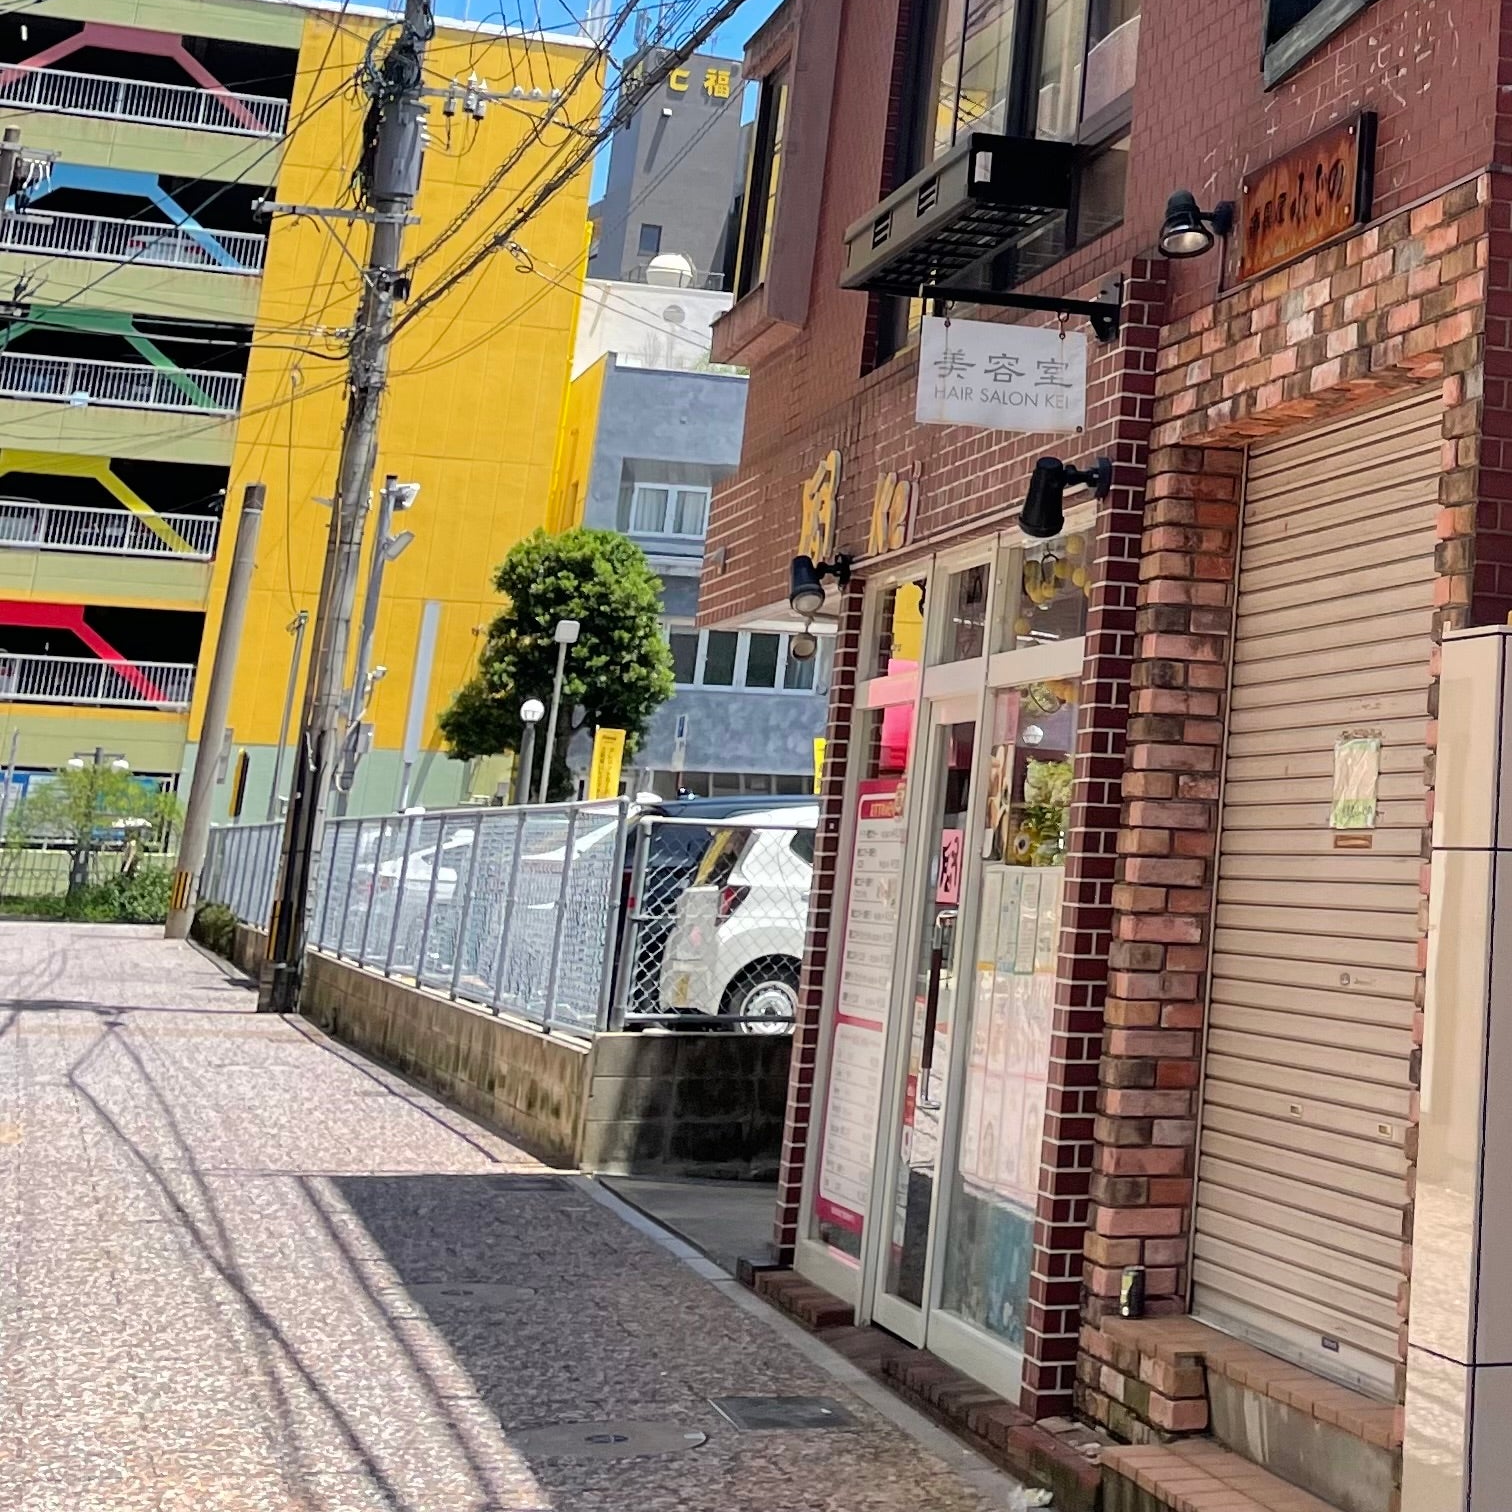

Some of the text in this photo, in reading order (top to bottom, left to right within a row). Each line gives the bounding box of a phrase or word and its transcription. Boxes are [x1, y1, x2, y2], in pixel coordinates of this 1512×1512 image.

[934, 349, 1073, 388] 美容室
[935, 385, 1069, 409] HAIR SALON KEI
